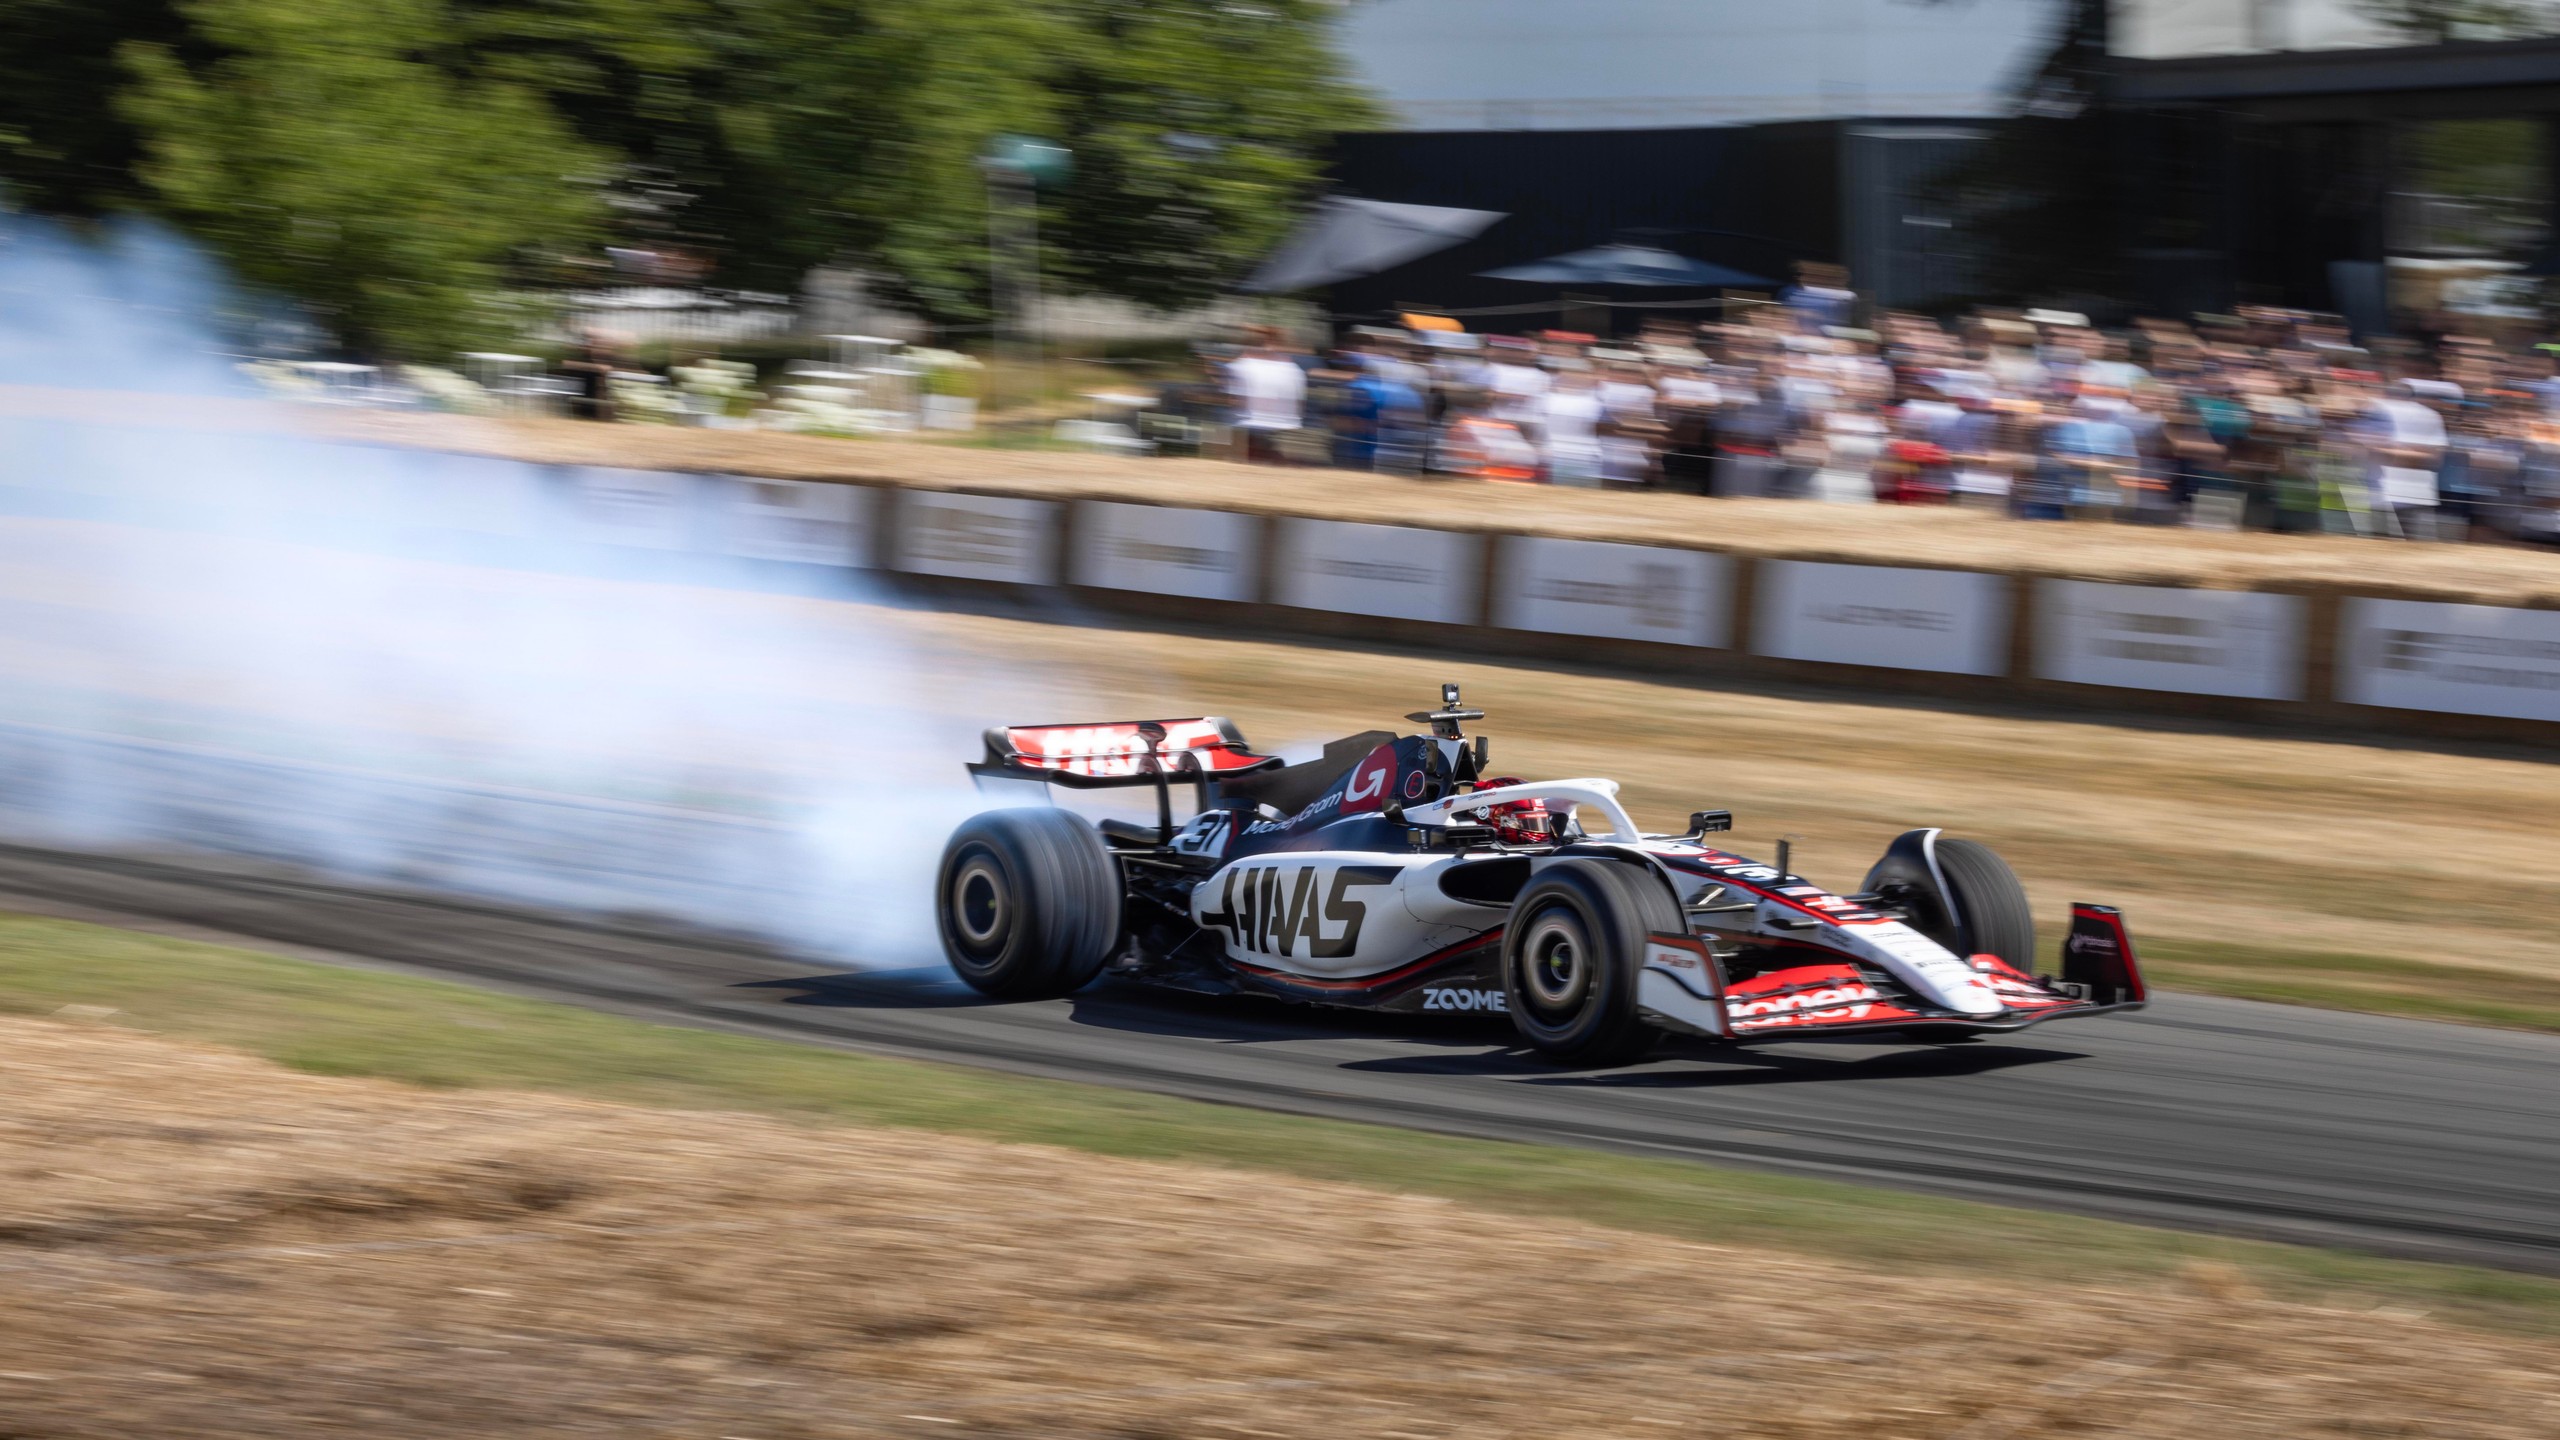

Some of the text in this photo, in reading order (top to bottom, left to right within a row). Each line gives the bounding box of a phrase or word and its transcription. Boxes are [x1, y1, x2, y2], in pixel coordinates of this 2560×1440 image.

[1241, 790, 1343, 836] MoneyGram
[1201, 866, 1406, 958] HAAS
[1423, 988, 1512, 1012] ZOOME
